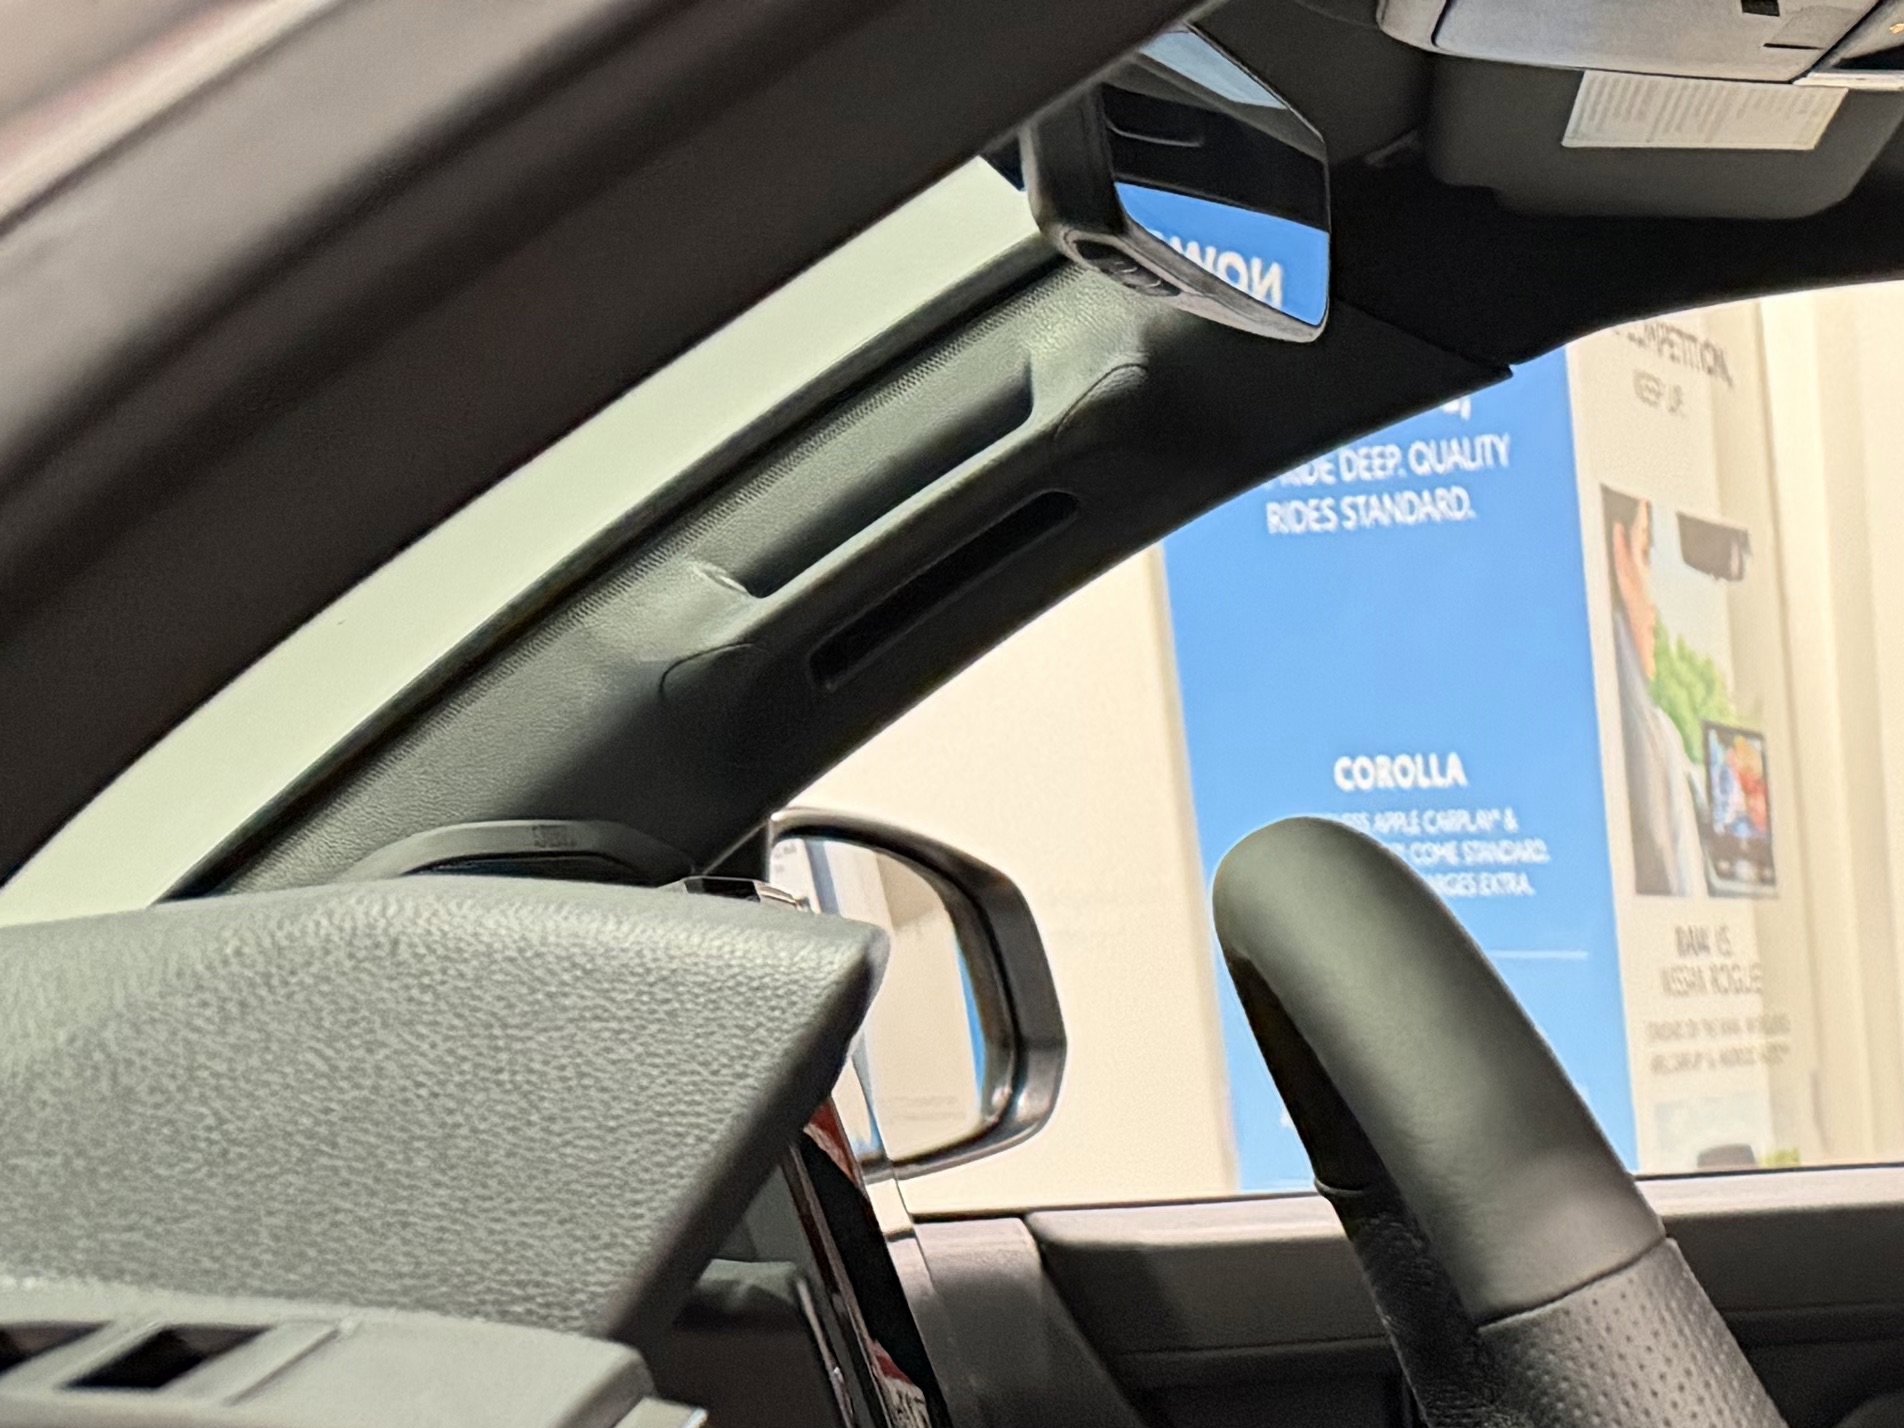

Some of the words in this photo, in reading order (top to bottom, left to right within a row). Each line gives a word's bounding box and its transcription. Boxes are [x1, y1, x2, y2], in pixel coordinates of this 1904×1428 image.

[1338, 443, 1408, 482] DEEP.
[1408, 432, 1511, 476] QUALITY
[1266, 497, 1339, 535] RIDES
[1340, 485, 1477, 530] STANDARD.
[1334, 752, 1468, 791] COROLLA
[1503, 806, 1519, 833] &
